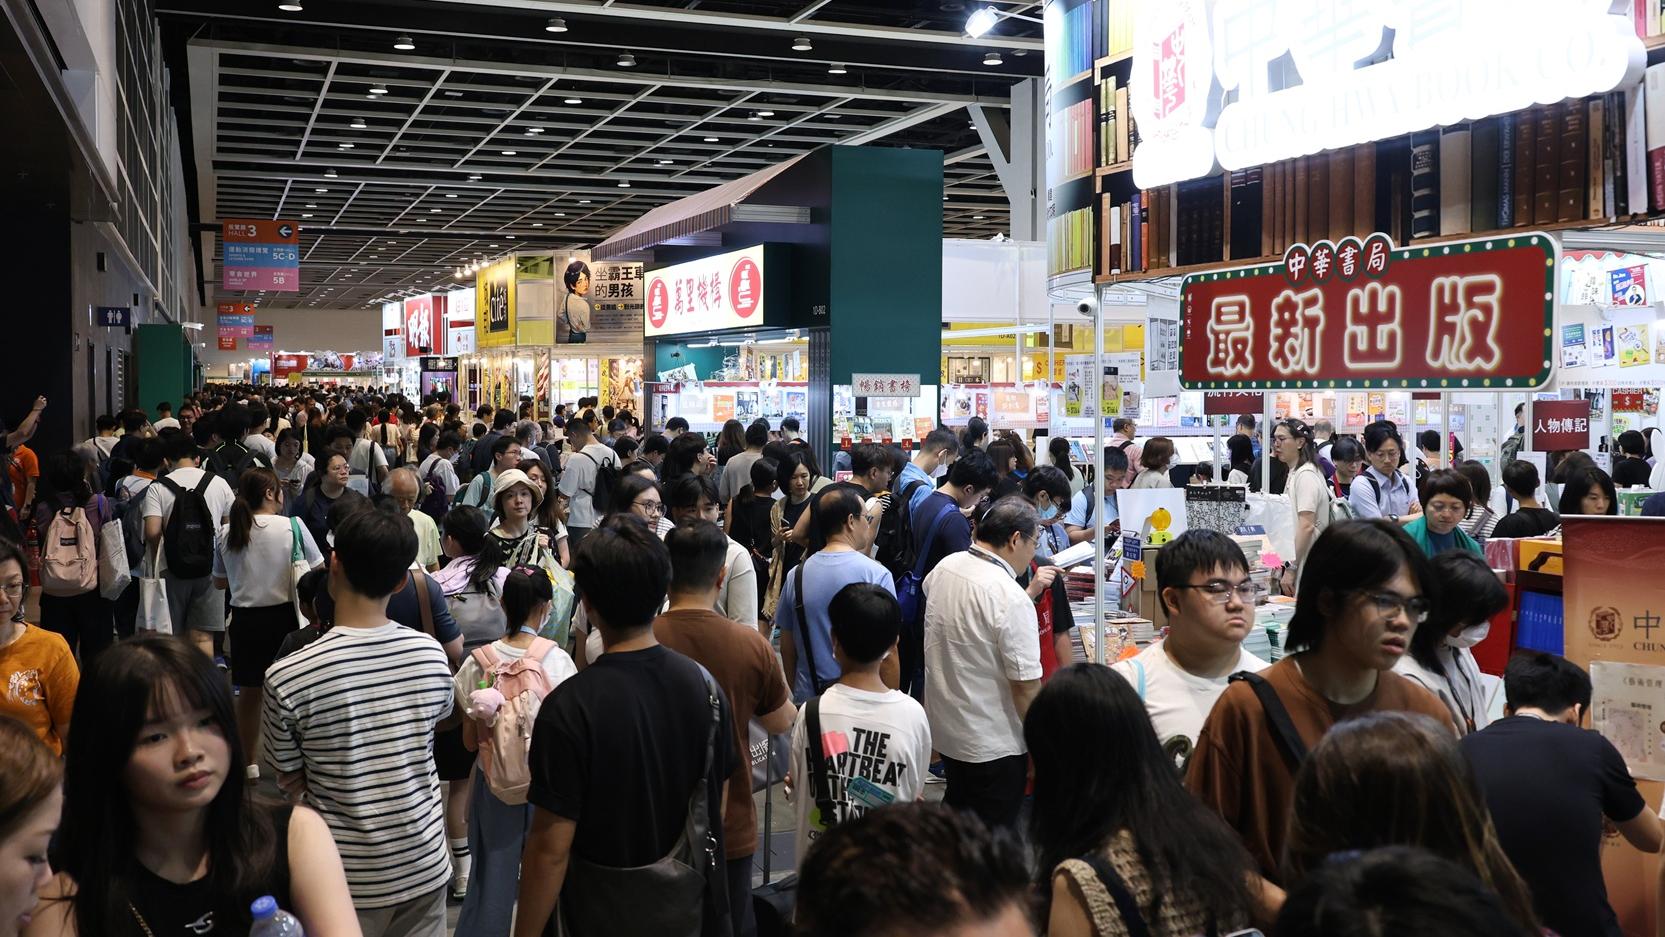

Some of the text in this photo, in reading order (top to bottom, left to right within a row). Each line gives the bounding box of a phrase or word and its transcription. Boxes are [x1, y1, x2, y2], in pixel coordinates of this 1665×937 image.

[247, 224, 257, 237] 3
[272, 252, 296, 260] 5C-D
[1289, 242, 1386, 281] 中華書局
[595, 266, 643, 281] 坐霸王車
[595, 283, 634, 298] 的男孩
[1204, 274, 1502, 377] 最新出版
[860, 379, 911, 393] 暢銷書榜
[1535, 417, 1588, 434] 人物傳記
[852, 727, 891, 759] THE
